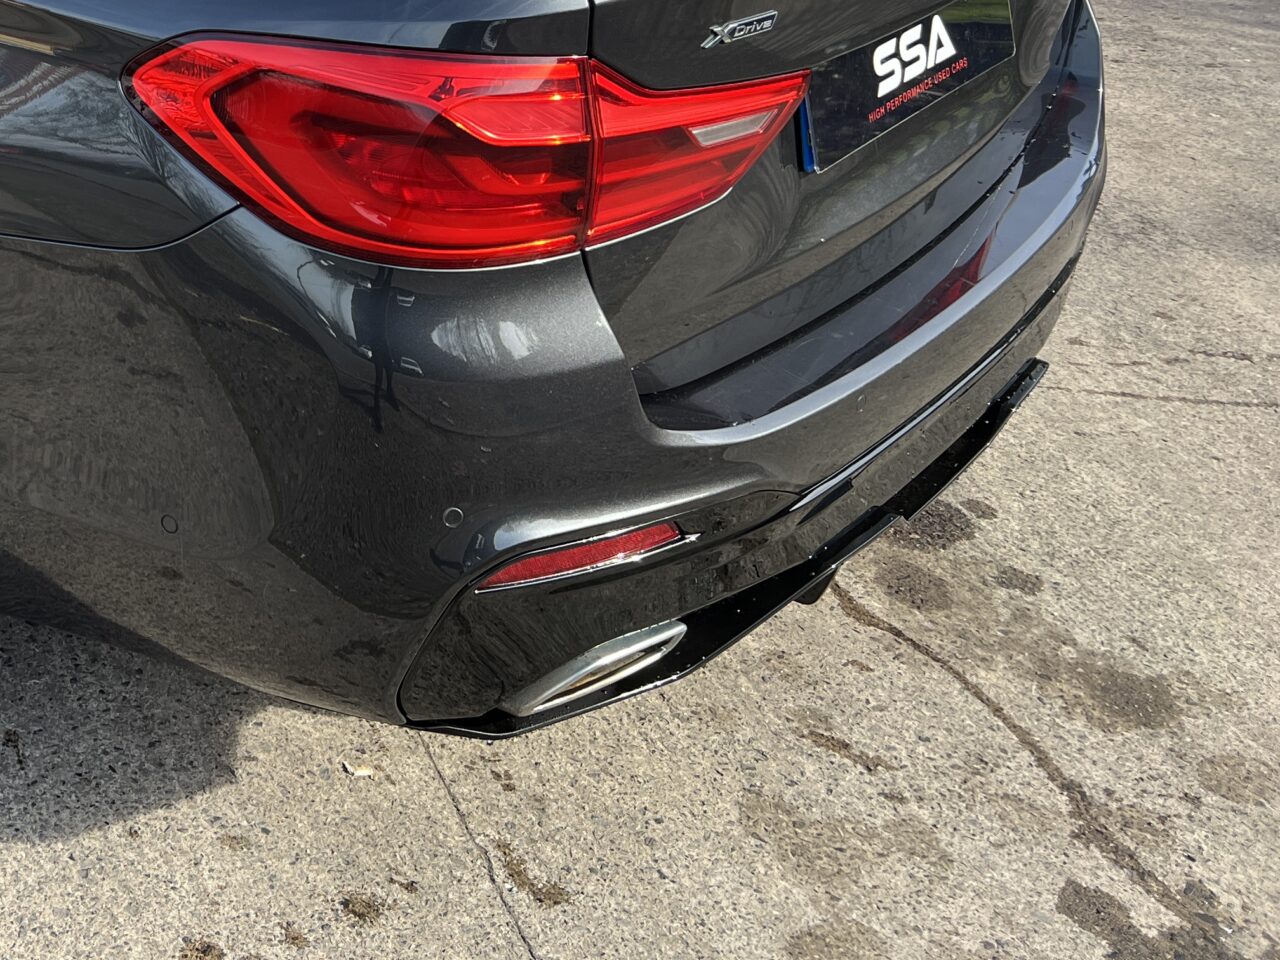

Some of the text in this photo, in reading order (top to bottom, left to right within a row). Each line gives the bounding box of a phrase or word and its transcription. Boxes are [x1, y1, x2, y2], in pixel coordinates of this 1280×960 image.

[868, 57, 968, 123] HIGH PERFORMANCE USED CARS
[873, 14, 957, 98] SSA
